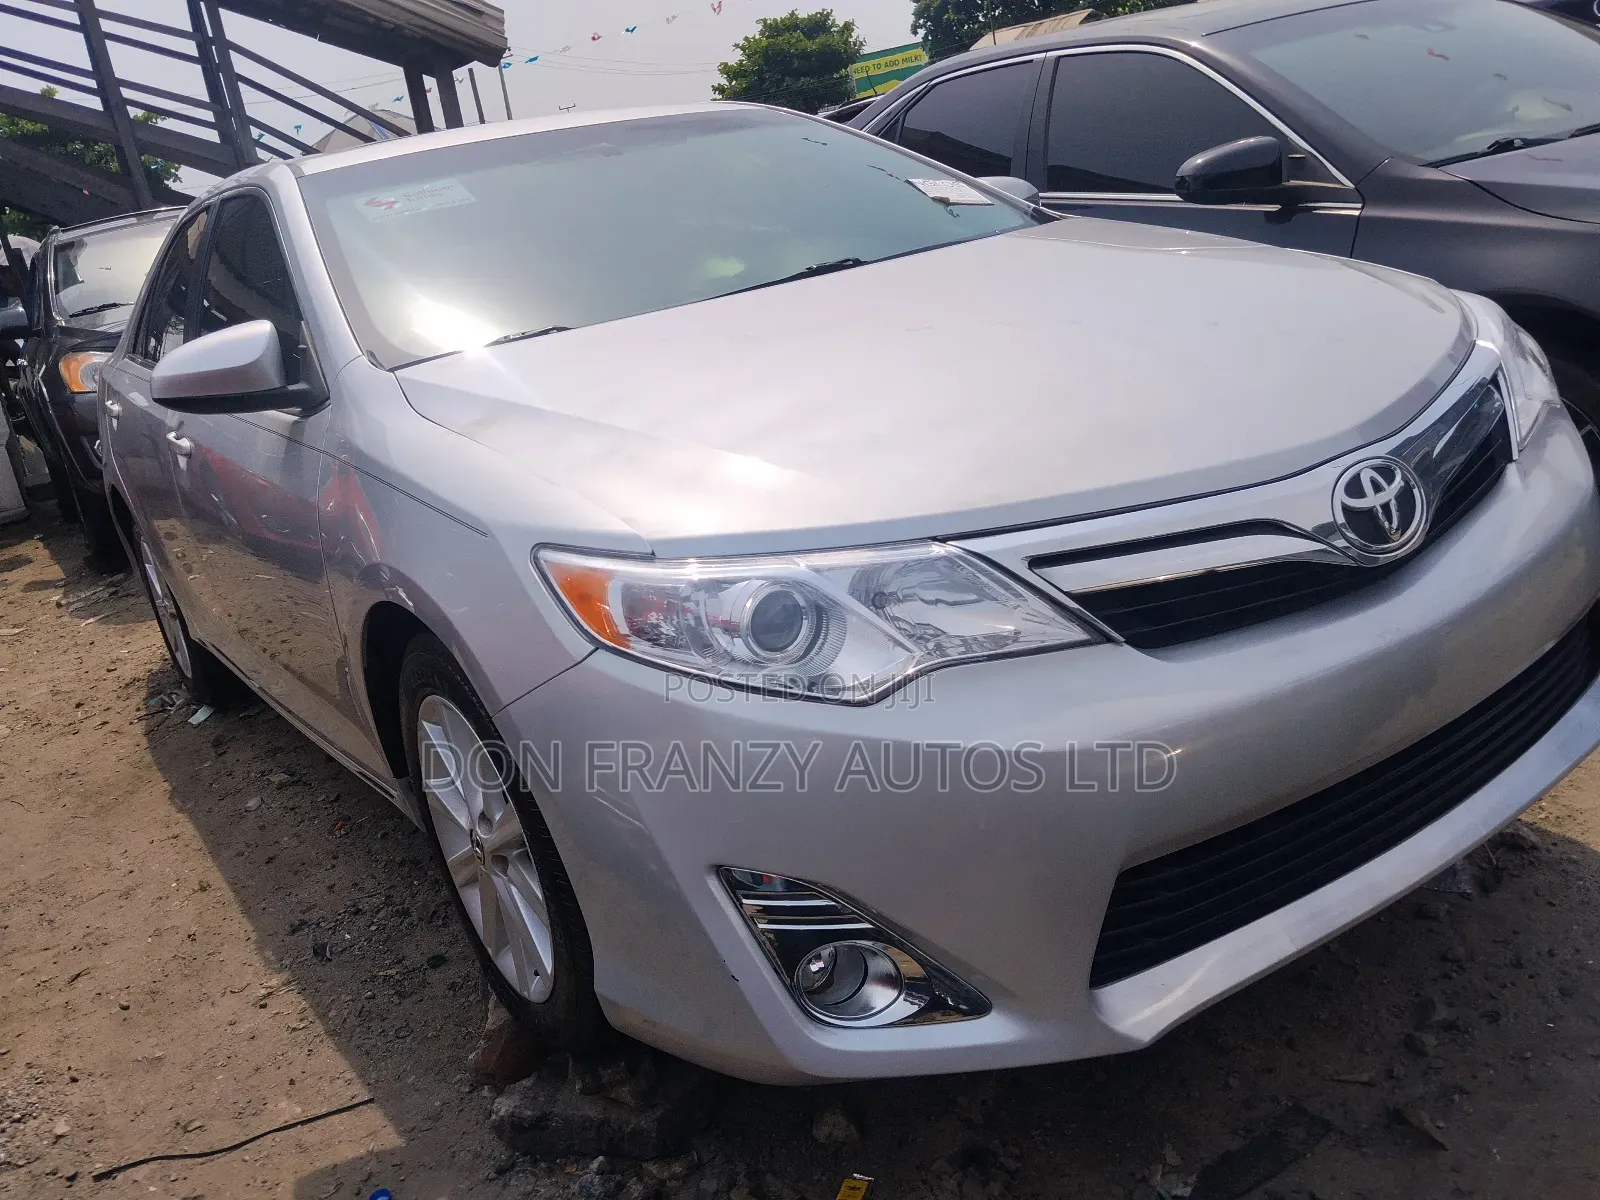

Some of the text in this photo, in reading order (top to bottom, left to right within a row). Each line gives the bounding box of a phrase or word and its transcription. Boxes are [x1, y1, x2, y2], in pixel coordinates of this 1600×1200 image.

[872, 62, 882, 71] TO
[884, 59, 900, 69] ADD
[901, 54, 922, 65] MILK!
